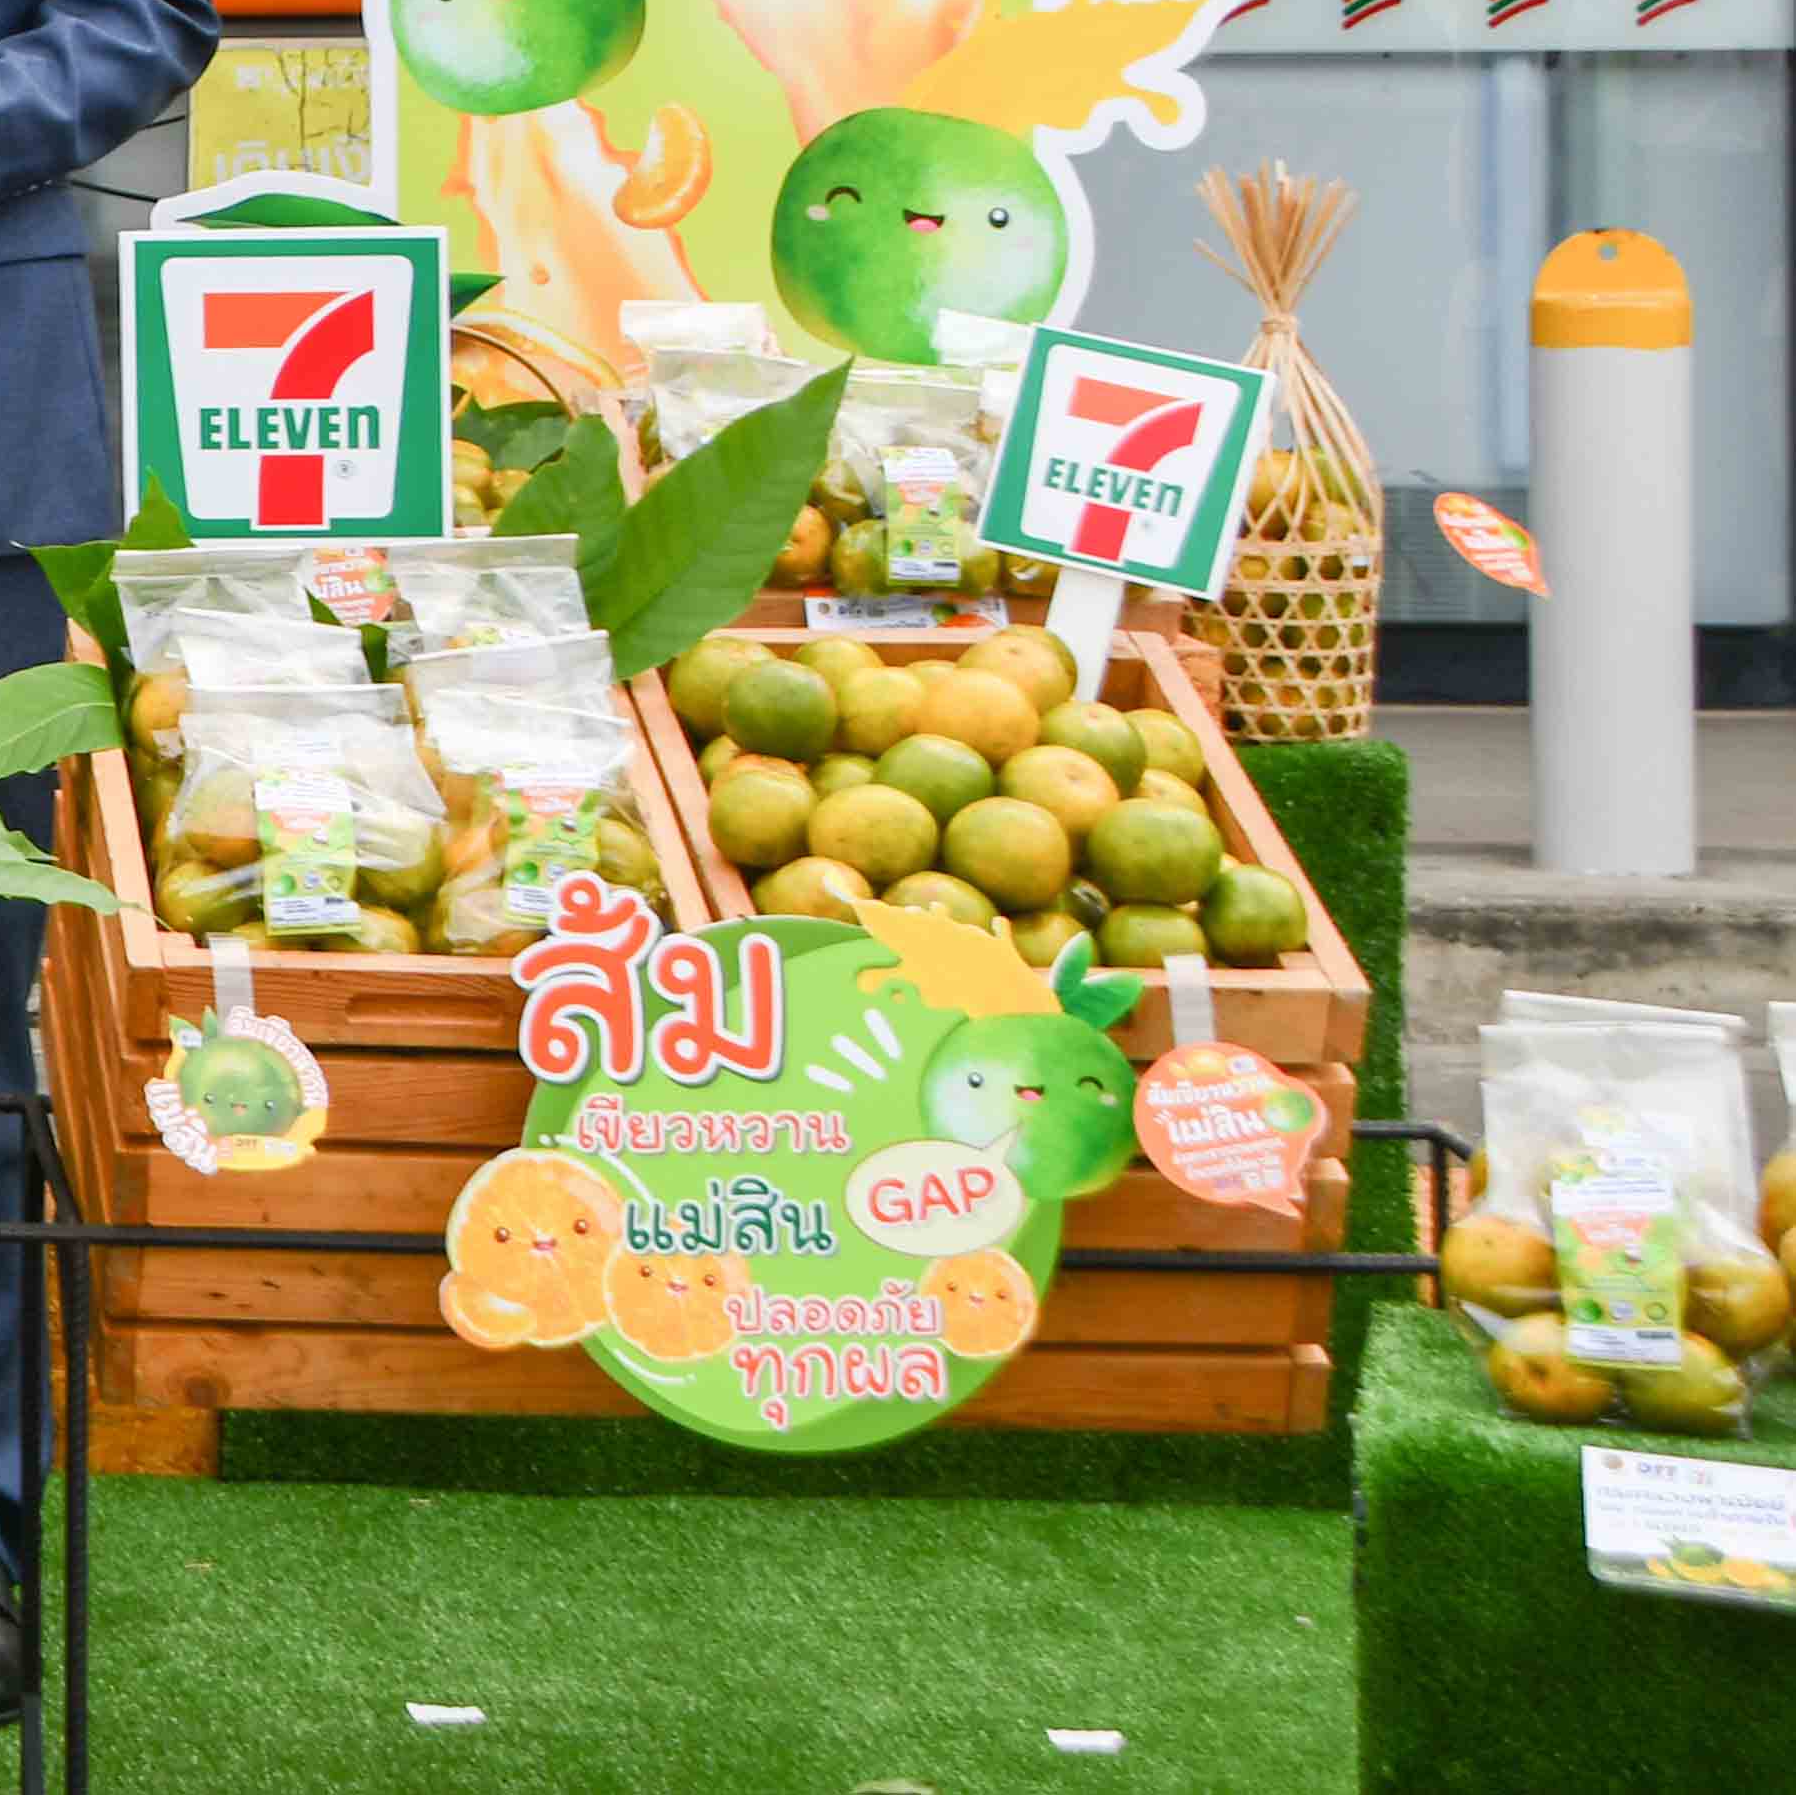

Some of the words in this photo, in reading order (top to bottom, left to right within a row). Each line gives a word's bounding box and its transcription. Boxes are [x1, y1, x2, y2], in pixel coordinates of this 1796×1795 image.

[519, 879, 776, 1077] ส้ม
[577, 1093, 850, 1153] เขียวหวาน
[625, 1177, 834, 1254] แม่สิน
[868, 1167, 996, 1224] GAP
[726, 1282, 940, 1335] ปลอดภัย
[734, 1344, 946, 1427] ทุกผล
